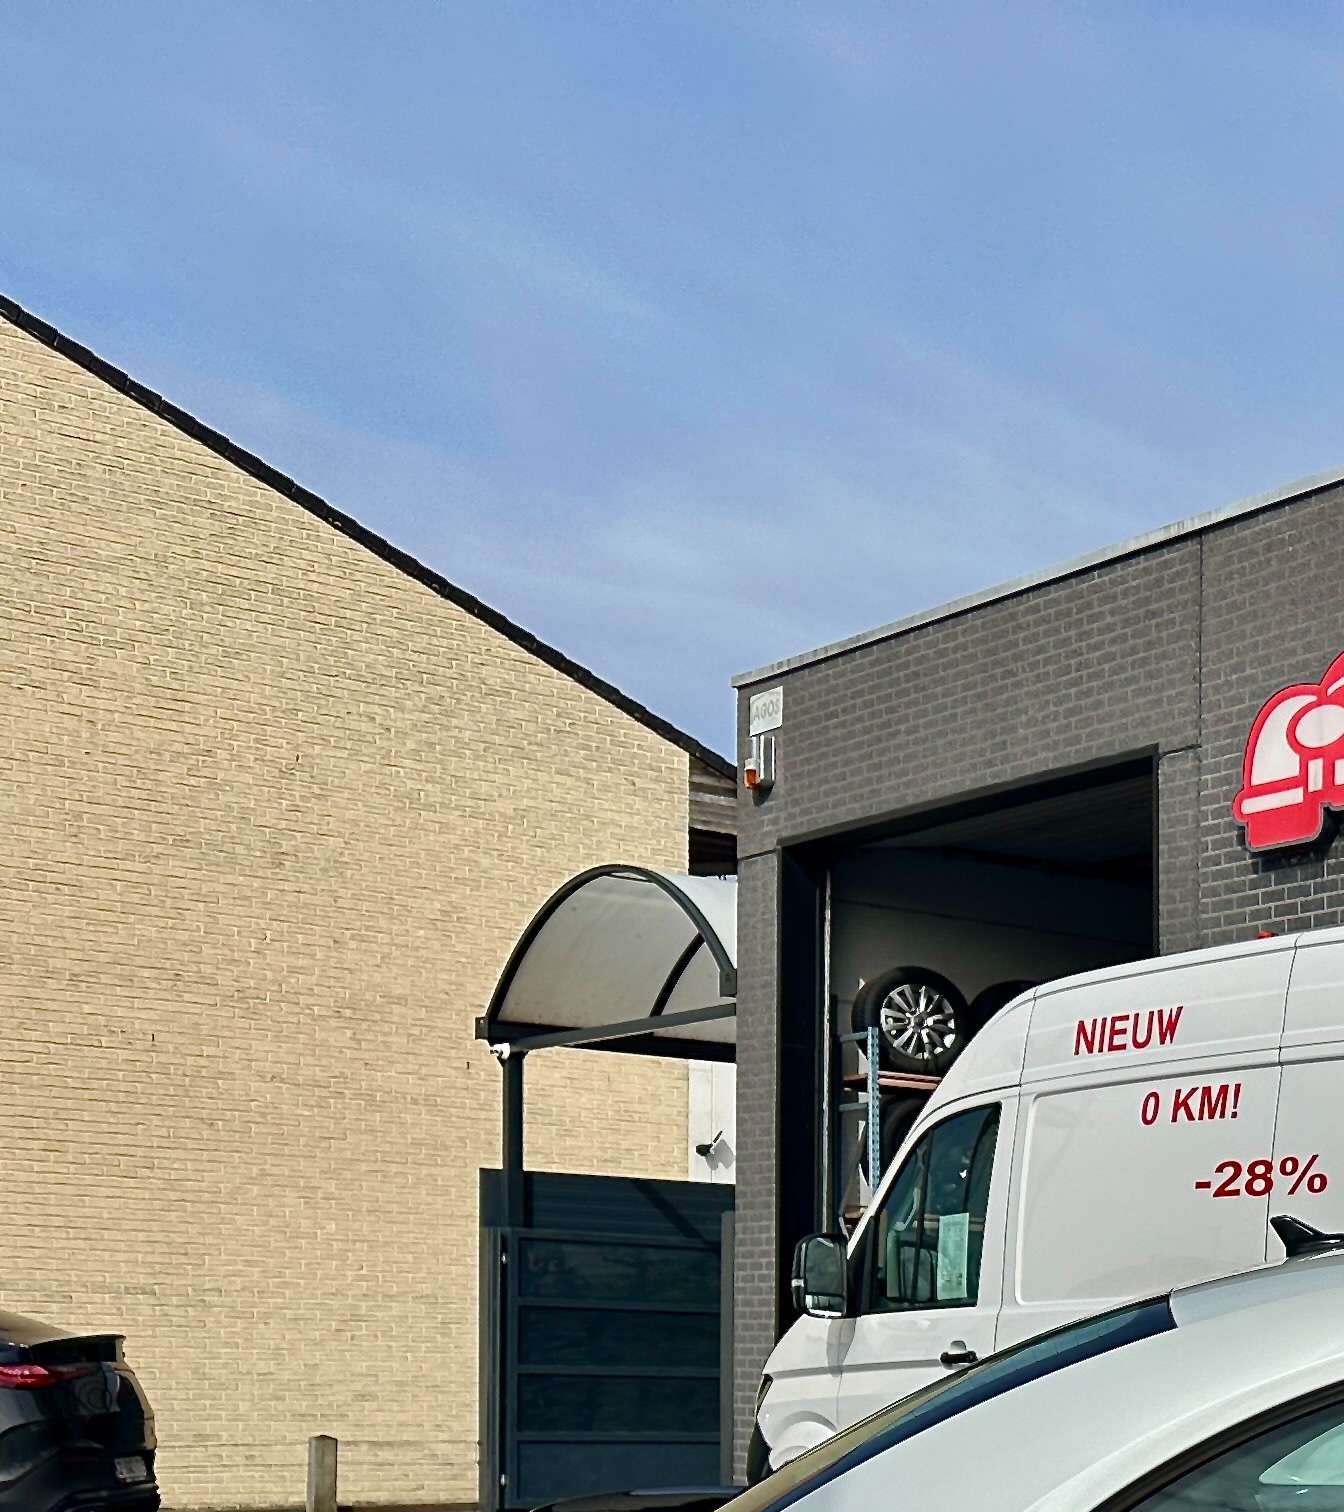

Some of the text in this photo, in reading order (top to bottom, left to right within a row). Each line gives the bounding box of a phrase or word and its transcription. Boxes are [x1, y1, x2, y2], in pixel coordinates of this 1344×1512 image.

[1073, 1005, 1184, 1056] NIEUW
[1140, 1083, 1242, 1126] 0 KM!
[1194, 1154, 1328, 1198] -28%
